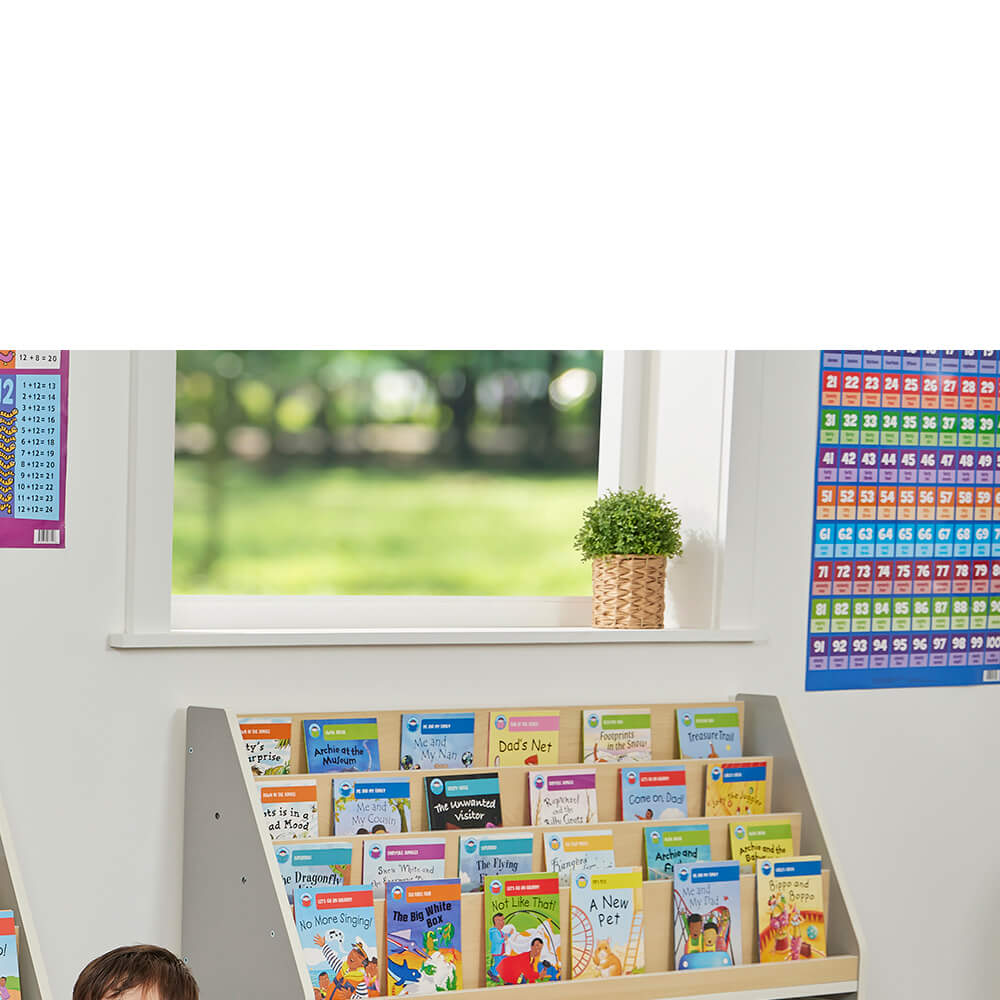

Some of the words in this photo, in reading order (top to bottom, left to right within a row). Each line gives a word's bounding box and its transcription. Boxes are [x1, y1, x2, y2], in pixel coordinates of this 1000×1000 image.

[826, 375, 837, 388] 21
[845, 376, 859, 389] 22
[865, 377, 879, 390] 23
[885, 378, 899, 391] 24
[904, 379, 918, 392] 25
[924, 379, 937, 391] 26
[943, 380, 956, 392] 27
[962, 381, 975, 393] 28
[981, 381, 995, 393] 29
[600, 731, 634, 742] Footprints
[688, 731, 718, 741] Treasure
[719, 730, 734, 741] Trail
[414, 739, 428, 747] Me
[431, 737, 446, 747] and
[499, 739, 527, 752] Dad's
[531, 739, 552, 752] Net
[617, 742, 625, 750] the
[314, 744, 339, 756] Archie
[351, 746, 364, 755] the
[421, 751, 435, 761] My
[439, 750, 457, 760] Nan
[322, 757, 356, 765] Museum
[629, 794, 650, 805] Come
[666, 792, 684, 803] Dad!
[280, 807, 286, 816] is
[291, 808, 299, 817] in
[357, 803, 370, 811] Me
[373, 802, 387, 811] and
[434, 803, 448, 813] The
[284, 820, 309, 830] Mood
[352, 815, 365, 824] My
[368, 814, 396, 825] Cousin
[739, 843, 761, 854] Archie
[763, 846, 774, 854] and
[776, 844, 785, 854] the
[656, 849, 681, 861] Archie
[683, 849, 697, 858] and
[477, 860, 490, 870] The
[493, 858, 518, 871] Flying
[281, 875, 291, 884] he
[295, 871, 340, 885] Dragonfly
[794, 880, 809, 888] and
[683, 888, 694, 896] Me
[697, 884, 710, 895] and
[492, 899, 509, 911] Not
[512, 897, 529, 908] Like
[533, 897, 556, 911] That!
[590, 898, 598, 912] A
[602, 896, 629, 909] New
[689, 897, 701, 908] My
[704, 896, 719, 906] Dad
[393, 911, 408, 922] The
[411, 908, 424, 921] Big
[425, 902, 452, 916] White
[300, 919, 312, 931] No
[315, 916, 338, 926] More
[340, 912, 372, 929] Singing!
[426, 915, 443, 928] Box
[598, 914, 620, 927] Pet
